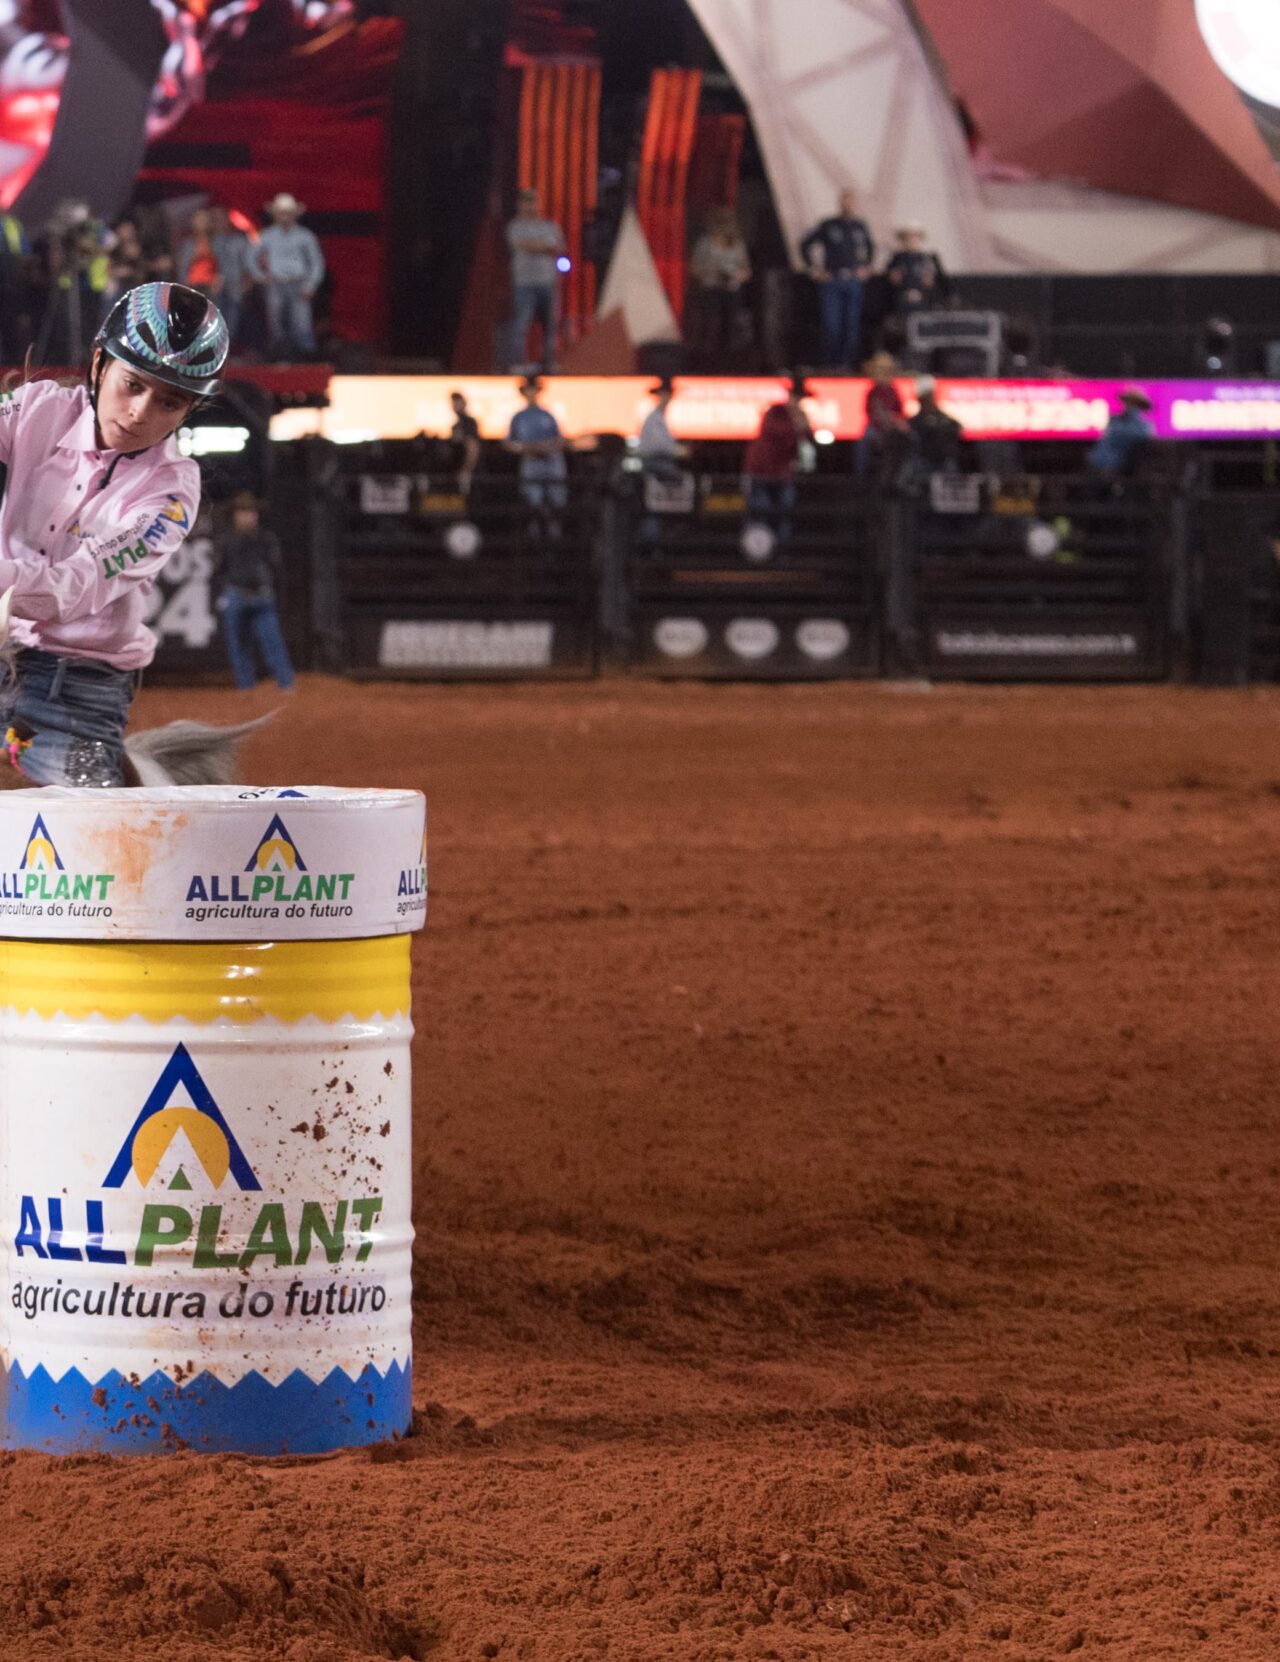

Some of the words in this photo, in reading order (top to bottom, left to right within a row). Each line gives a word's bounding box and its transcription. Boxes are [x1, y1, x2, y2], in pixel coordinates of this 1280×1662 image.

[46, 902, 64, 916] do
[67, 902, 113, 917] futuro
[185, 904, 280, 921] agricultura
[285, 904, 306, 918] do
[310, 903, 353, 917] futuro
[11, 1278, 206, 1320] agricultura
[219, 1281, 275, 1318] do
[284, 1280, 387, 1317] futuro
